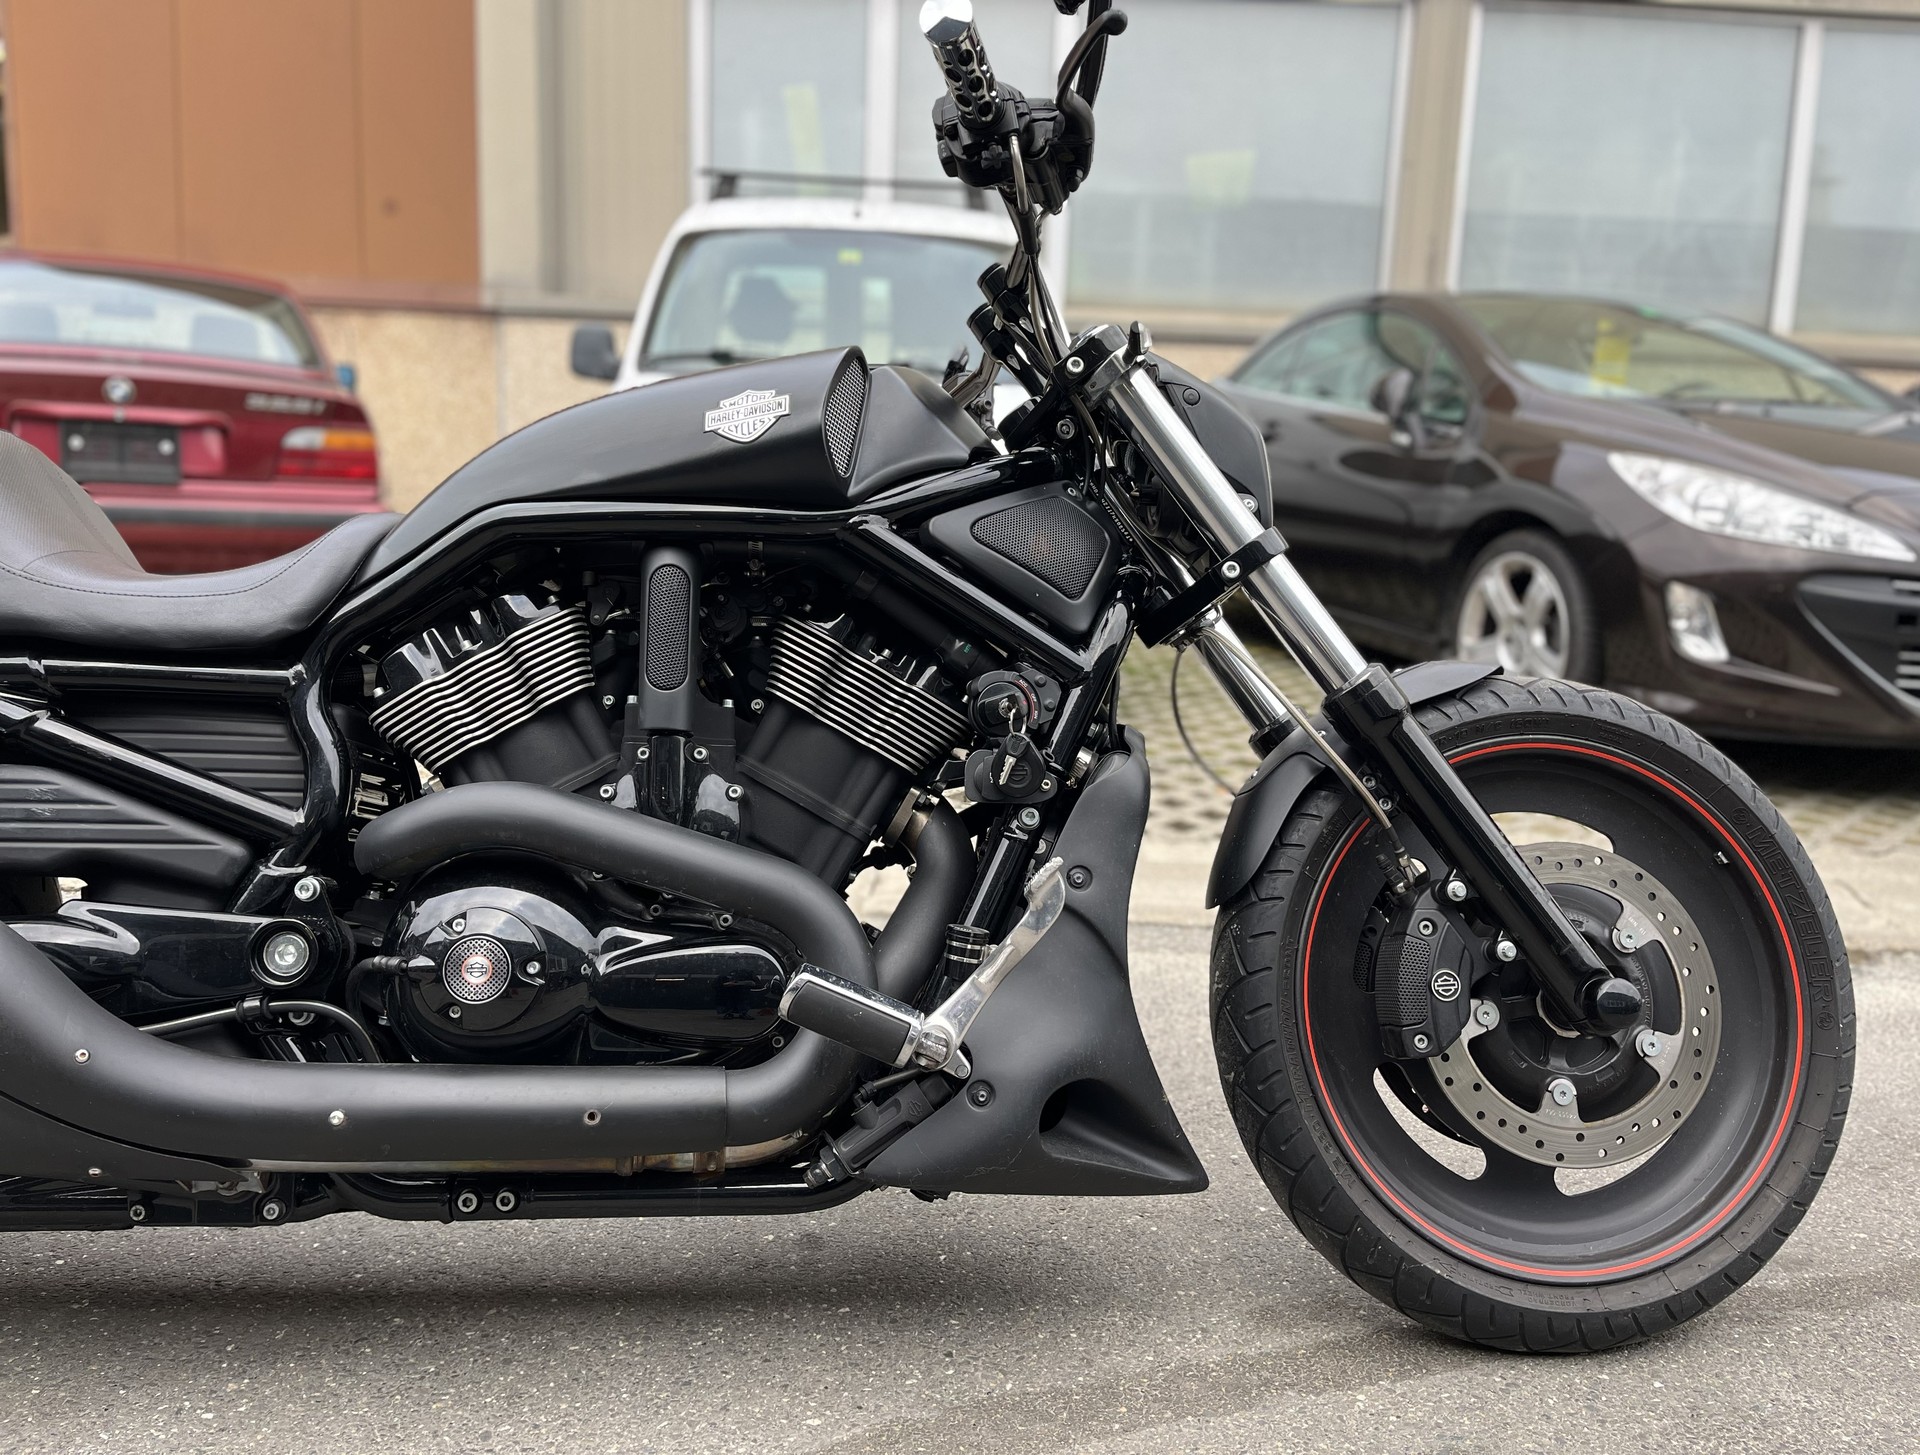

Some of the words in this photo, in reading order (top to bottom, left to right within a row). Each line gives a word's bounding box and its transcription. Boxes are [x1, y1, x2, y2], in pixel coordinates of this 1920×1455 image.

[728, 394, 767, 408] MOTOR
[710, 401, 783, 425] HARLEY-DAVIDSON
[728, 418, 765, 436] CYCLES
[1747, 825, 1833, 1002] METZELER
